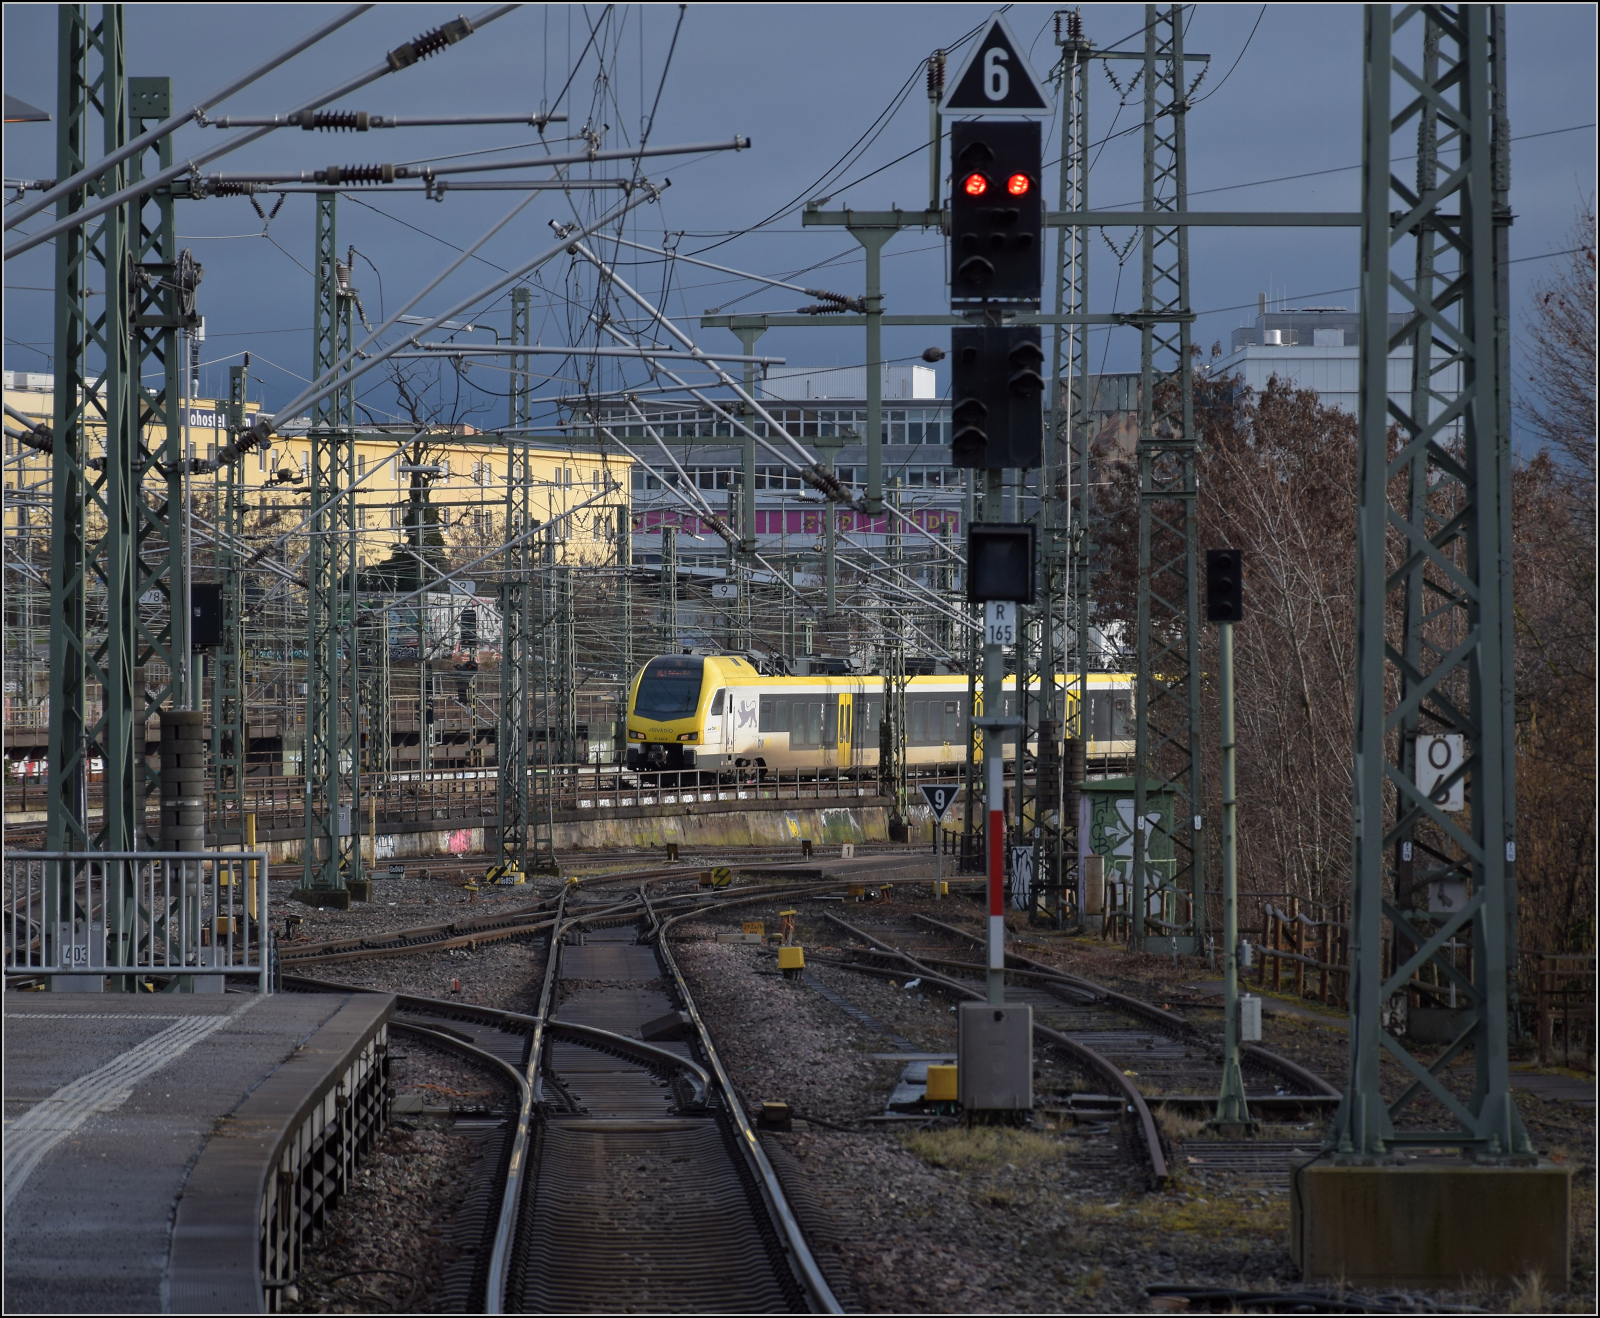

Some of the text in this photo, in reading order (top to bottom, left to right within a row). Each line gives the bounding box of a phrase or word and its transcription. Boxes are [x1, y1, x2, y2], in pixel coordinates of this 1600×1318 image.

[983, 46, 1010, 102] 6
[720, 585, 729, 597] 9
[995, 604, 1005, 620] R
[989, 624, 1012, 641] 165
[1428, 738, 1452, 770] 0
[934, 790, 946, 810] 9
[846, 846, 851, 857] 1
